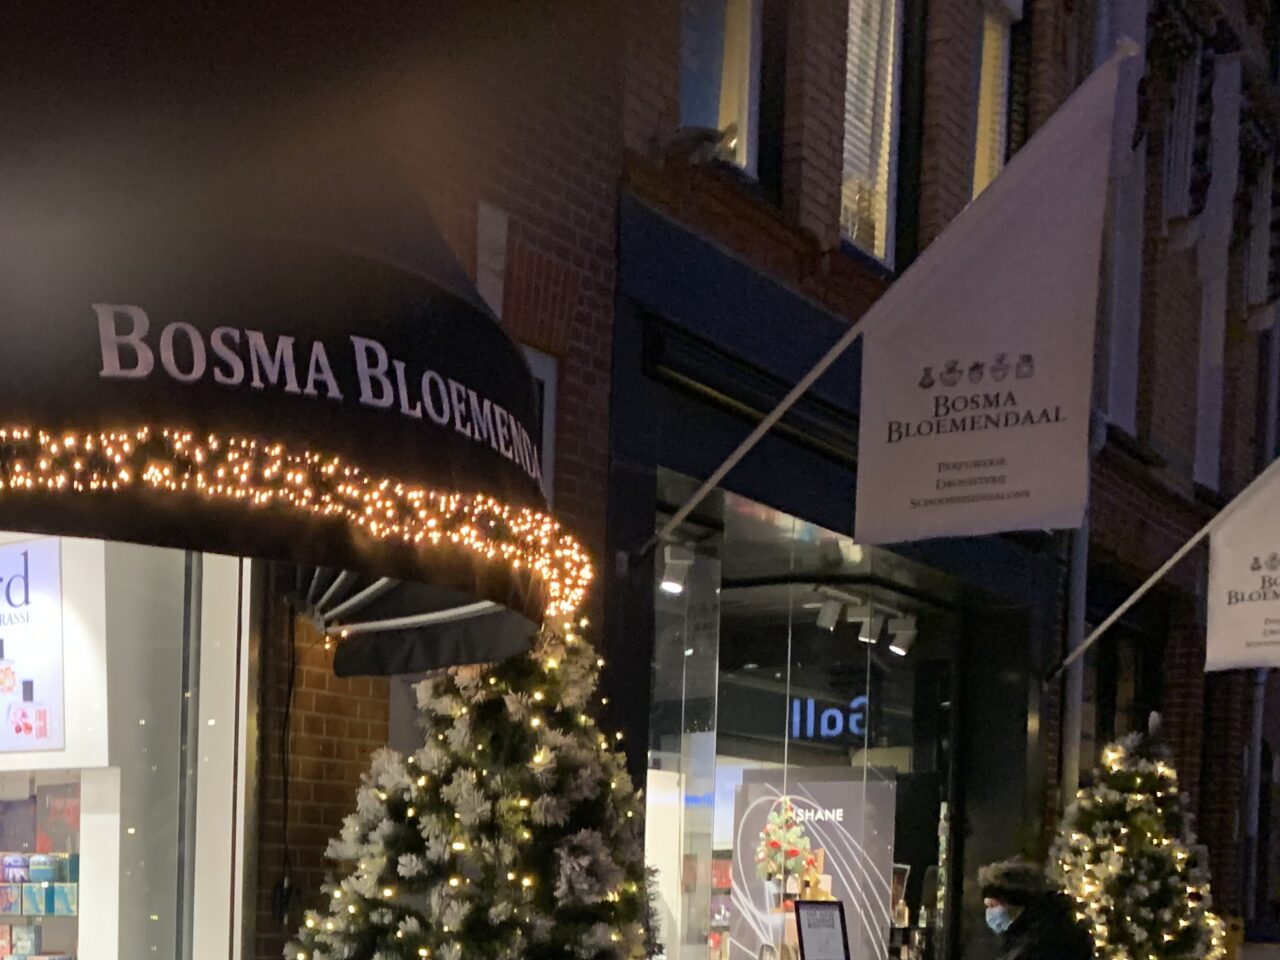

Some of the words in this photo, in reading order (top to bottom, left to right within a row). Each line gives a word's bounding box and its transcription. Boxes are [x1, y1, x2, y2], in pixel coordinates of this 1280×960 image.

[91, 303, 344, 400] BOSMA
[932, 391, 1017, 418] BOSMA
[886, 406, 1067, 443] BLOEMENDAAL
